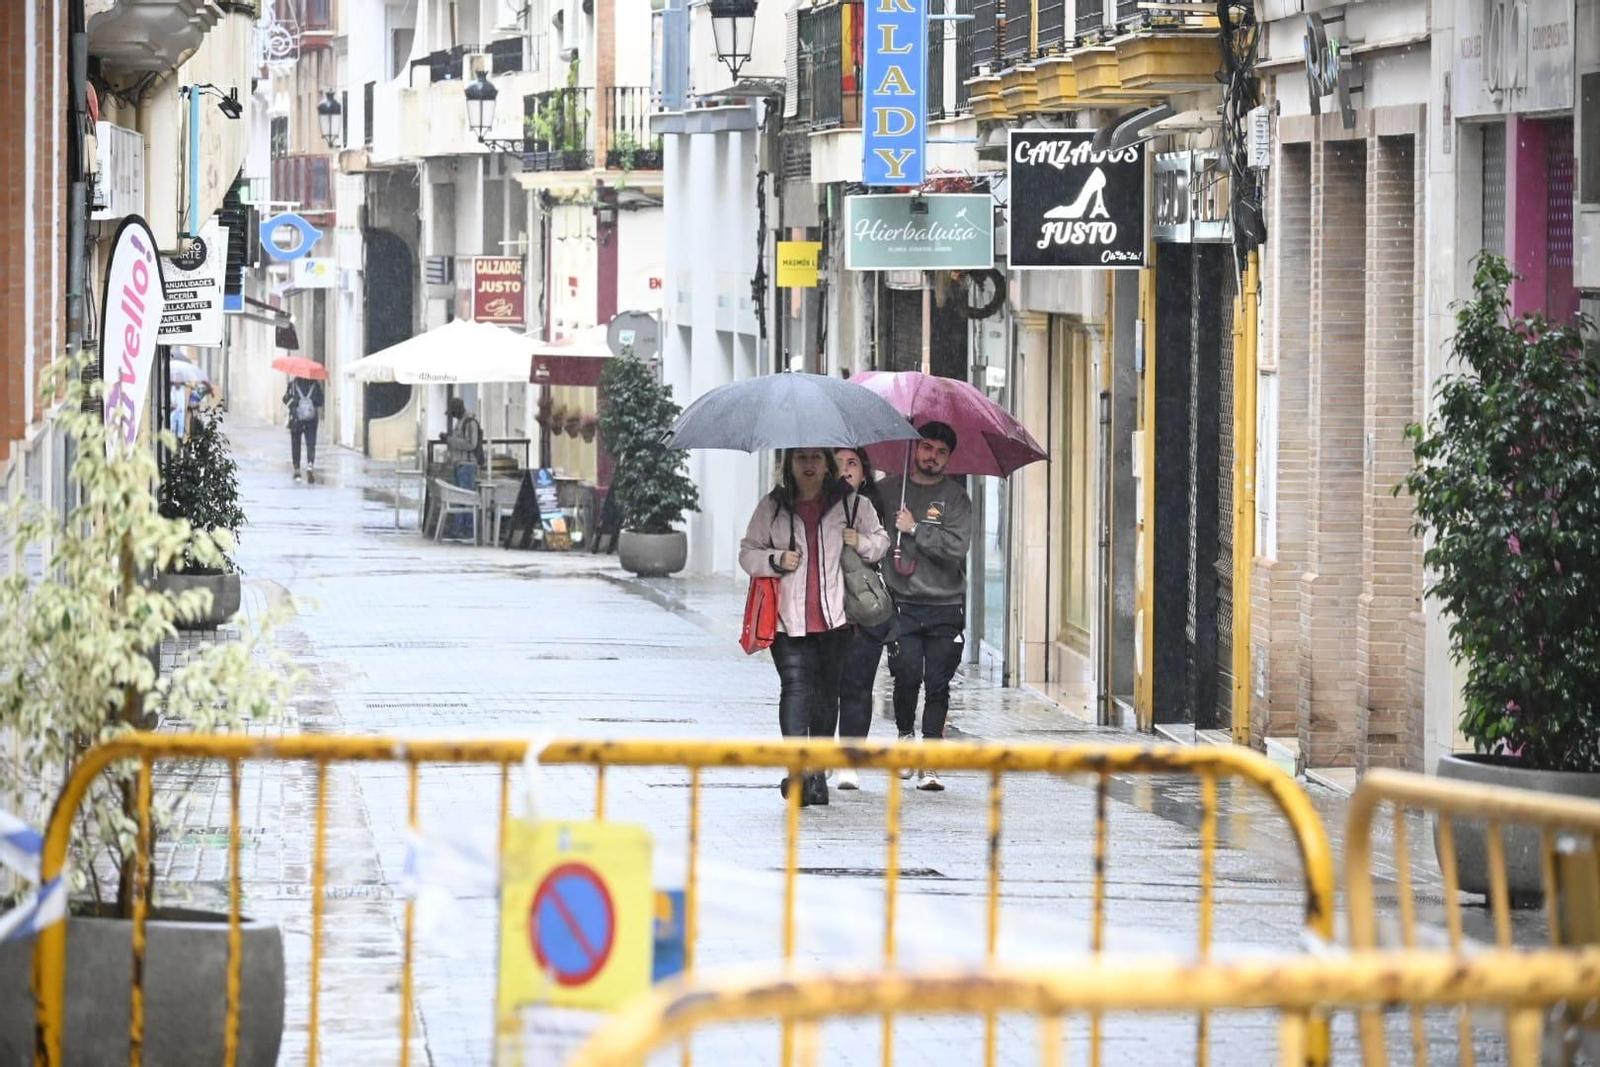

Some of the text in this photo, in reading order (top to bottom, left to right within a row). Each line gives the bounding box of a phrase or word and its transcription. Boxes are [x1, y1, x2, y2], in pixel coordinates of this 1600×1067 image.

[853, 218, 977, 242] Hierbaluisa
[1036, 221, 1118, 250] JUSTO
[166, 279, 212, 289] ANUALIDADES
[478, 280, 521, 293] JUSTO
[163, 302, 208, 311] ELLAS ARTES
